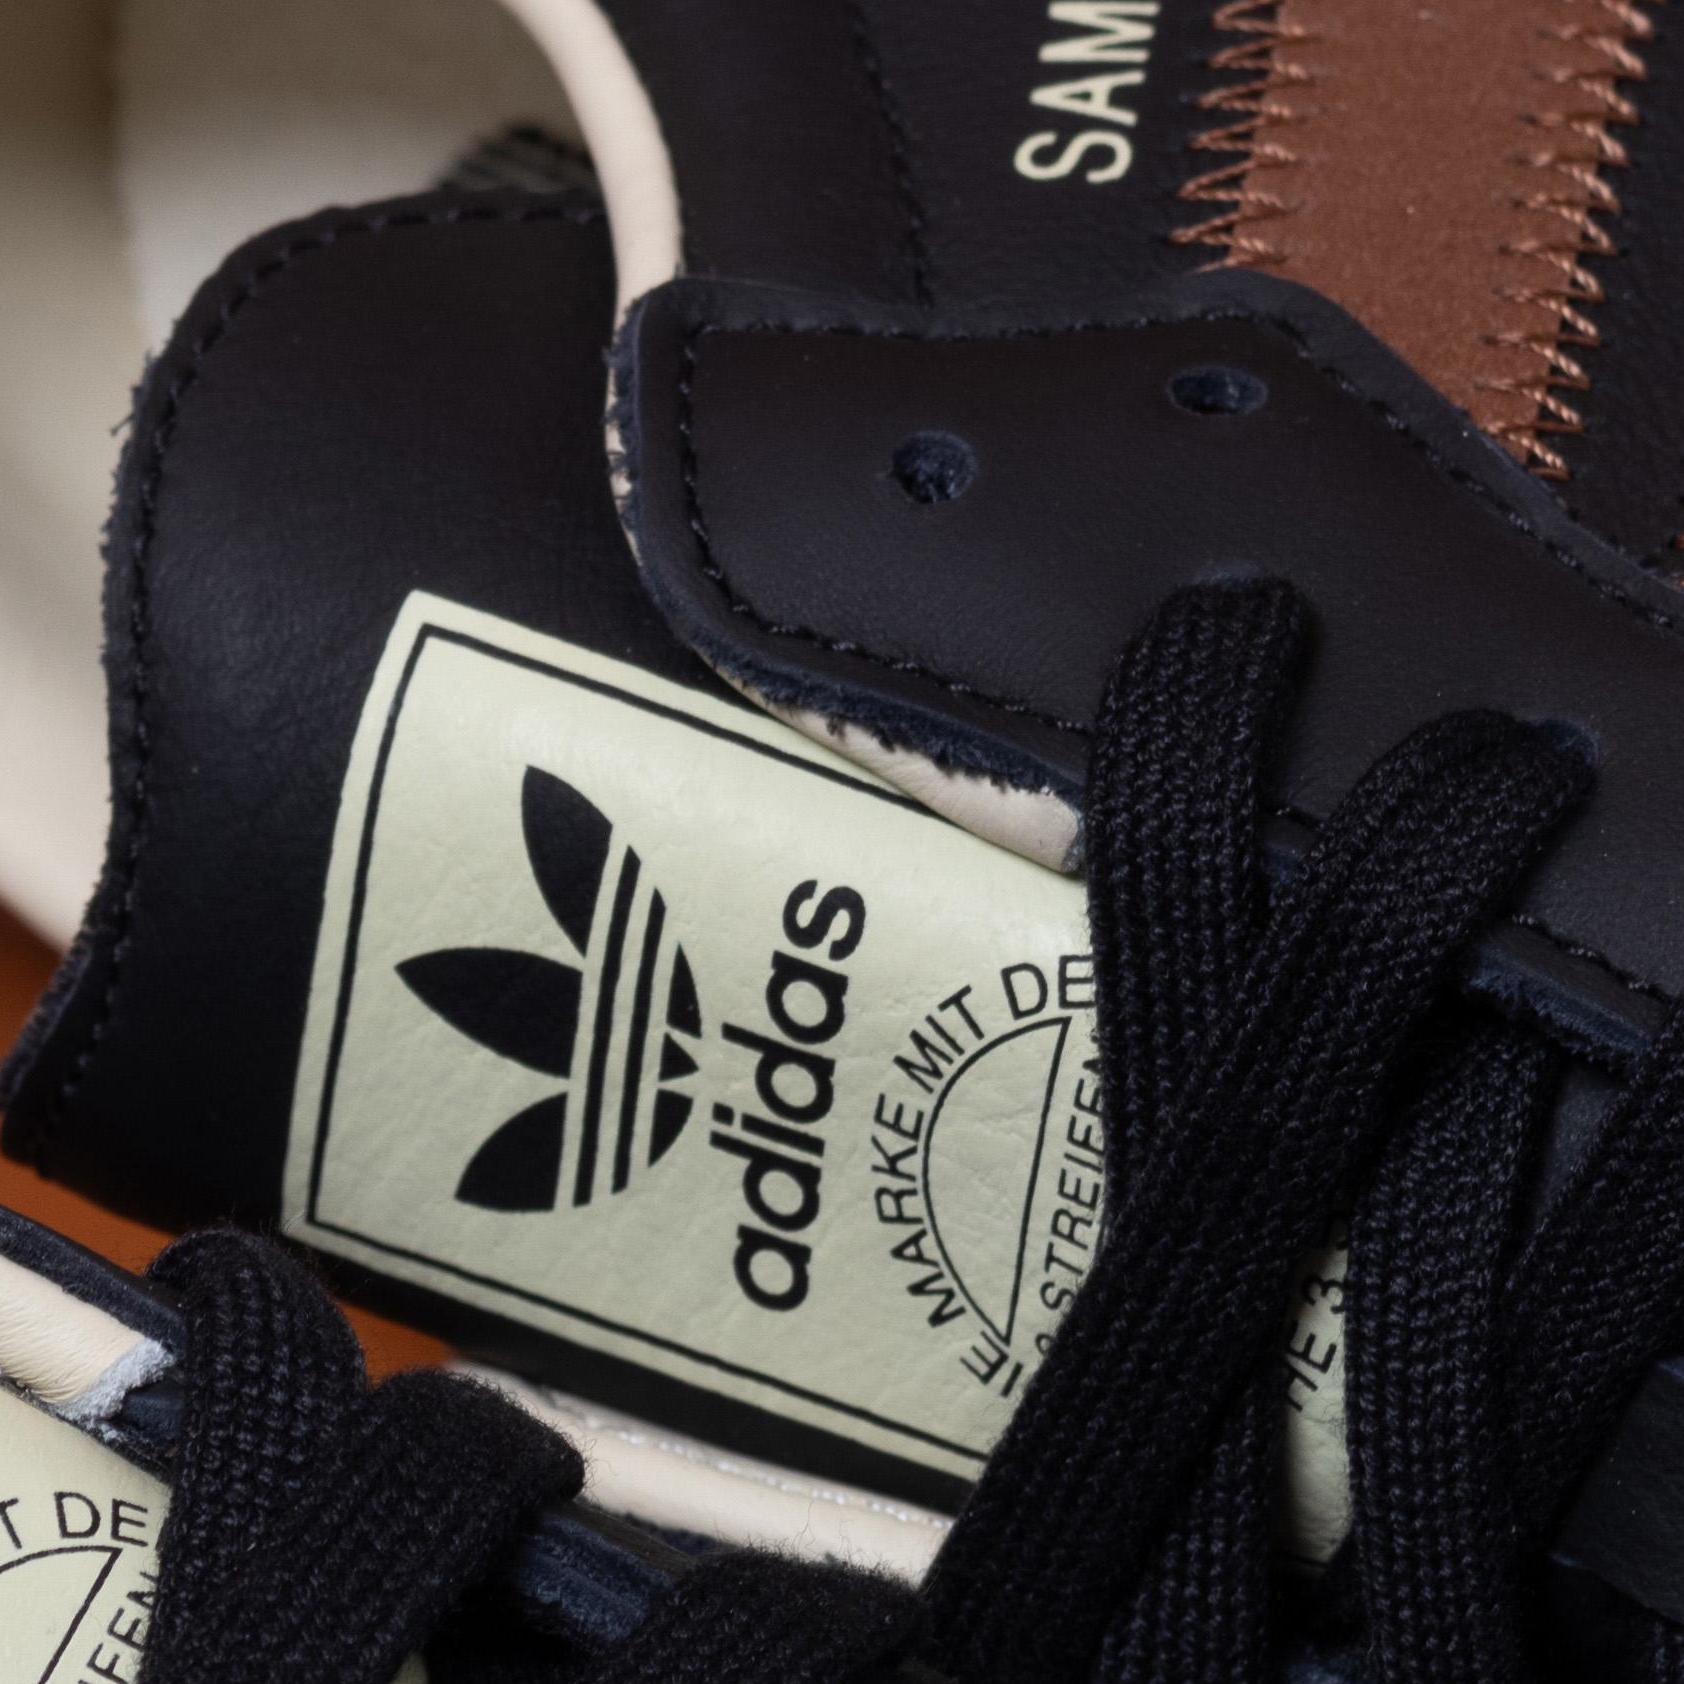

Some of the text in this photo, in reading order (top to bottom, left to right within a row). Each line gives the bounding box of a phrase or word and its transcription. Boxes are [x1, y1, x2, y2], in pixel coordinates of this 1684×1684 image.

[1014, 0, 1160, 183] SAM
[707, 878, 866, 1312] adidas
[892, 984, 985, 1095] MIT
[871, 1092, 966, 1328] MARKE
